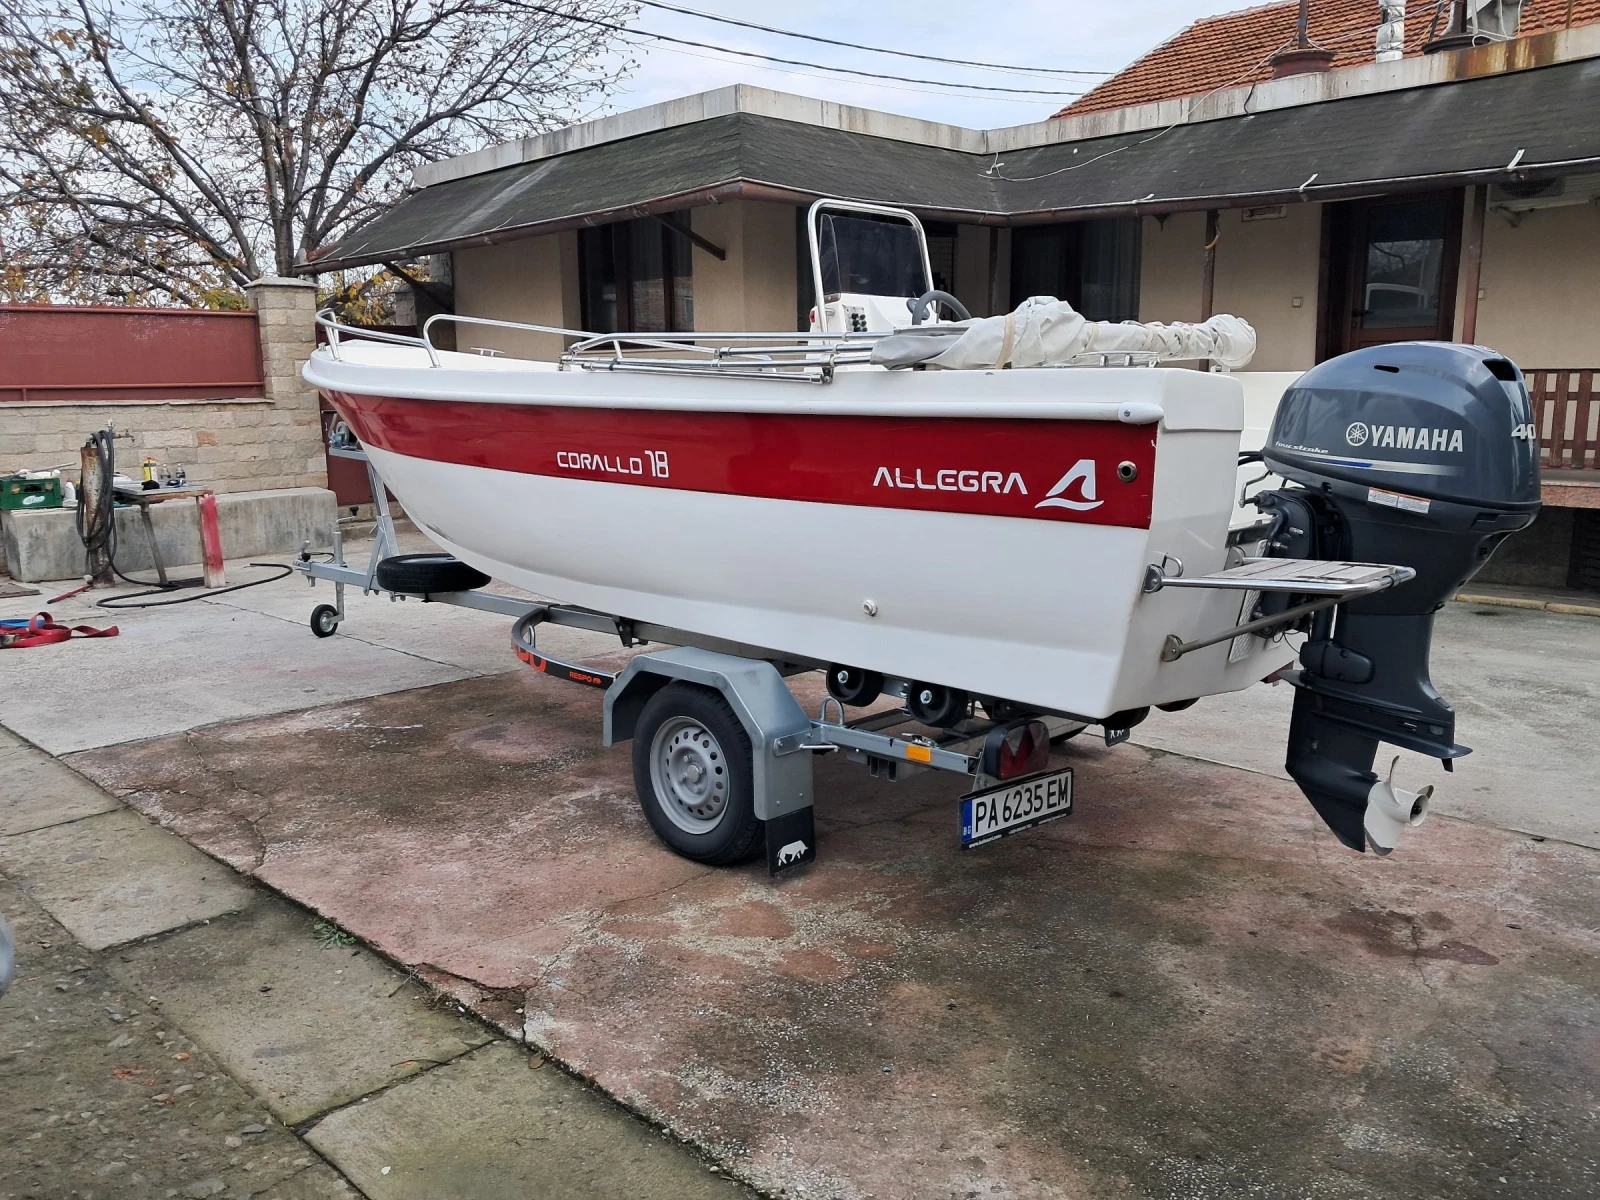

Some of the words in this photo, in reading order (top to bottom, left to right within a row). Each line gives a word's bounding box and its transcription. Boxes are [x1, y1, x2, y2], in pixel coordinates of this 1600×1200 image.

[1371, 424, 1464, 452] YAMAHA
[1511, 423, 1536, 440] 40
[556, 451, 643, 475] CORALLO
[872, 466, 1028, 495] ALLEGRA
[569, 671, 592, 683] RESPO
[963, 826, 972, 836] BG
